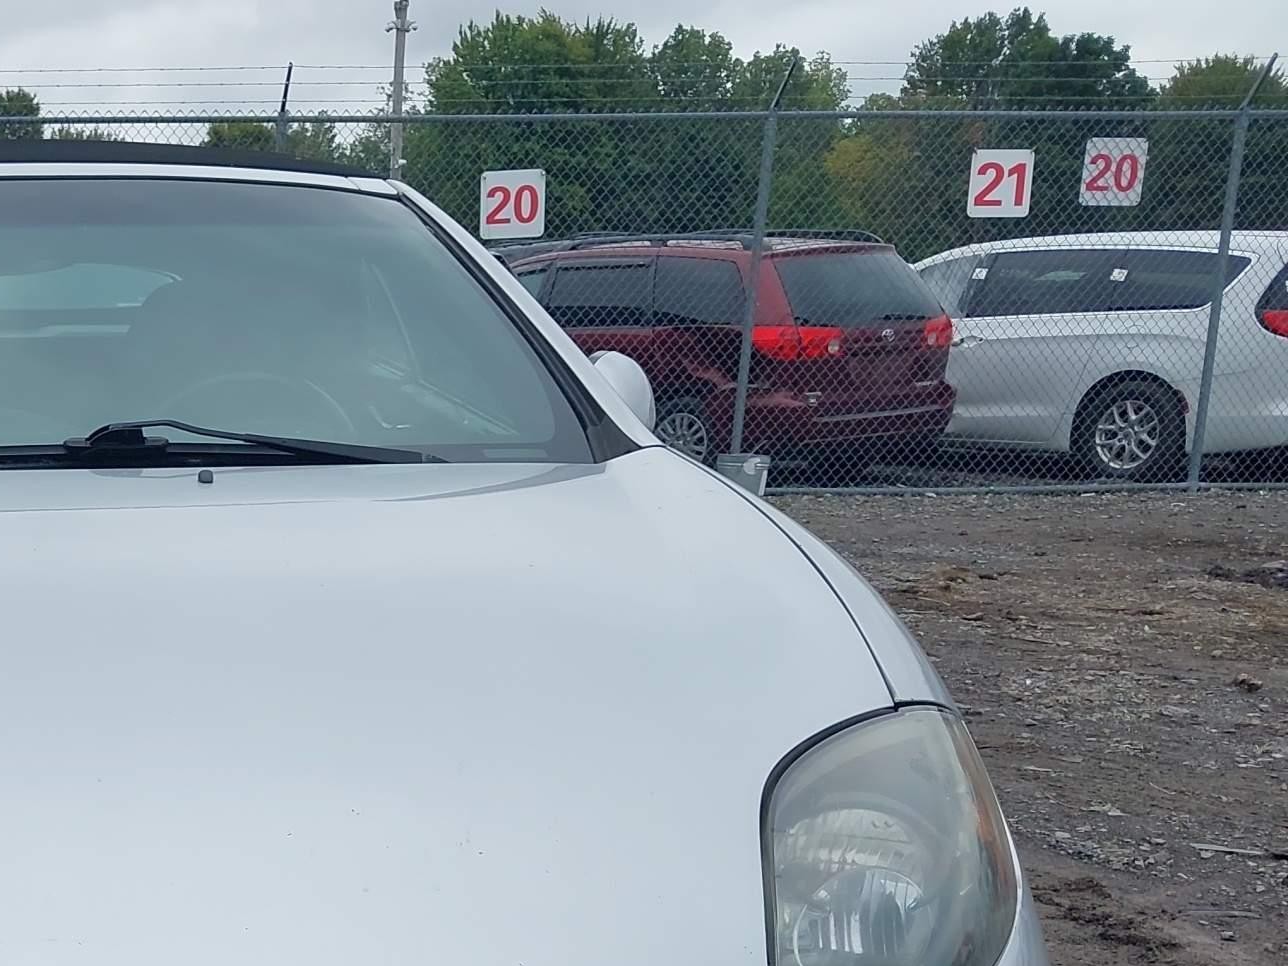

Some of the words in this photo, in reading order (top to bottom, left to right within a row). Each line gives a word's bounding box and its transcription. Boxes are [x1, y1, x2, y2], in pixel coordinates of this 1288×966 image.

[973, 162, 1028, 207] 21
[1086, 153, 1141, 192] 20
[486, 184, 539, 225] 20
